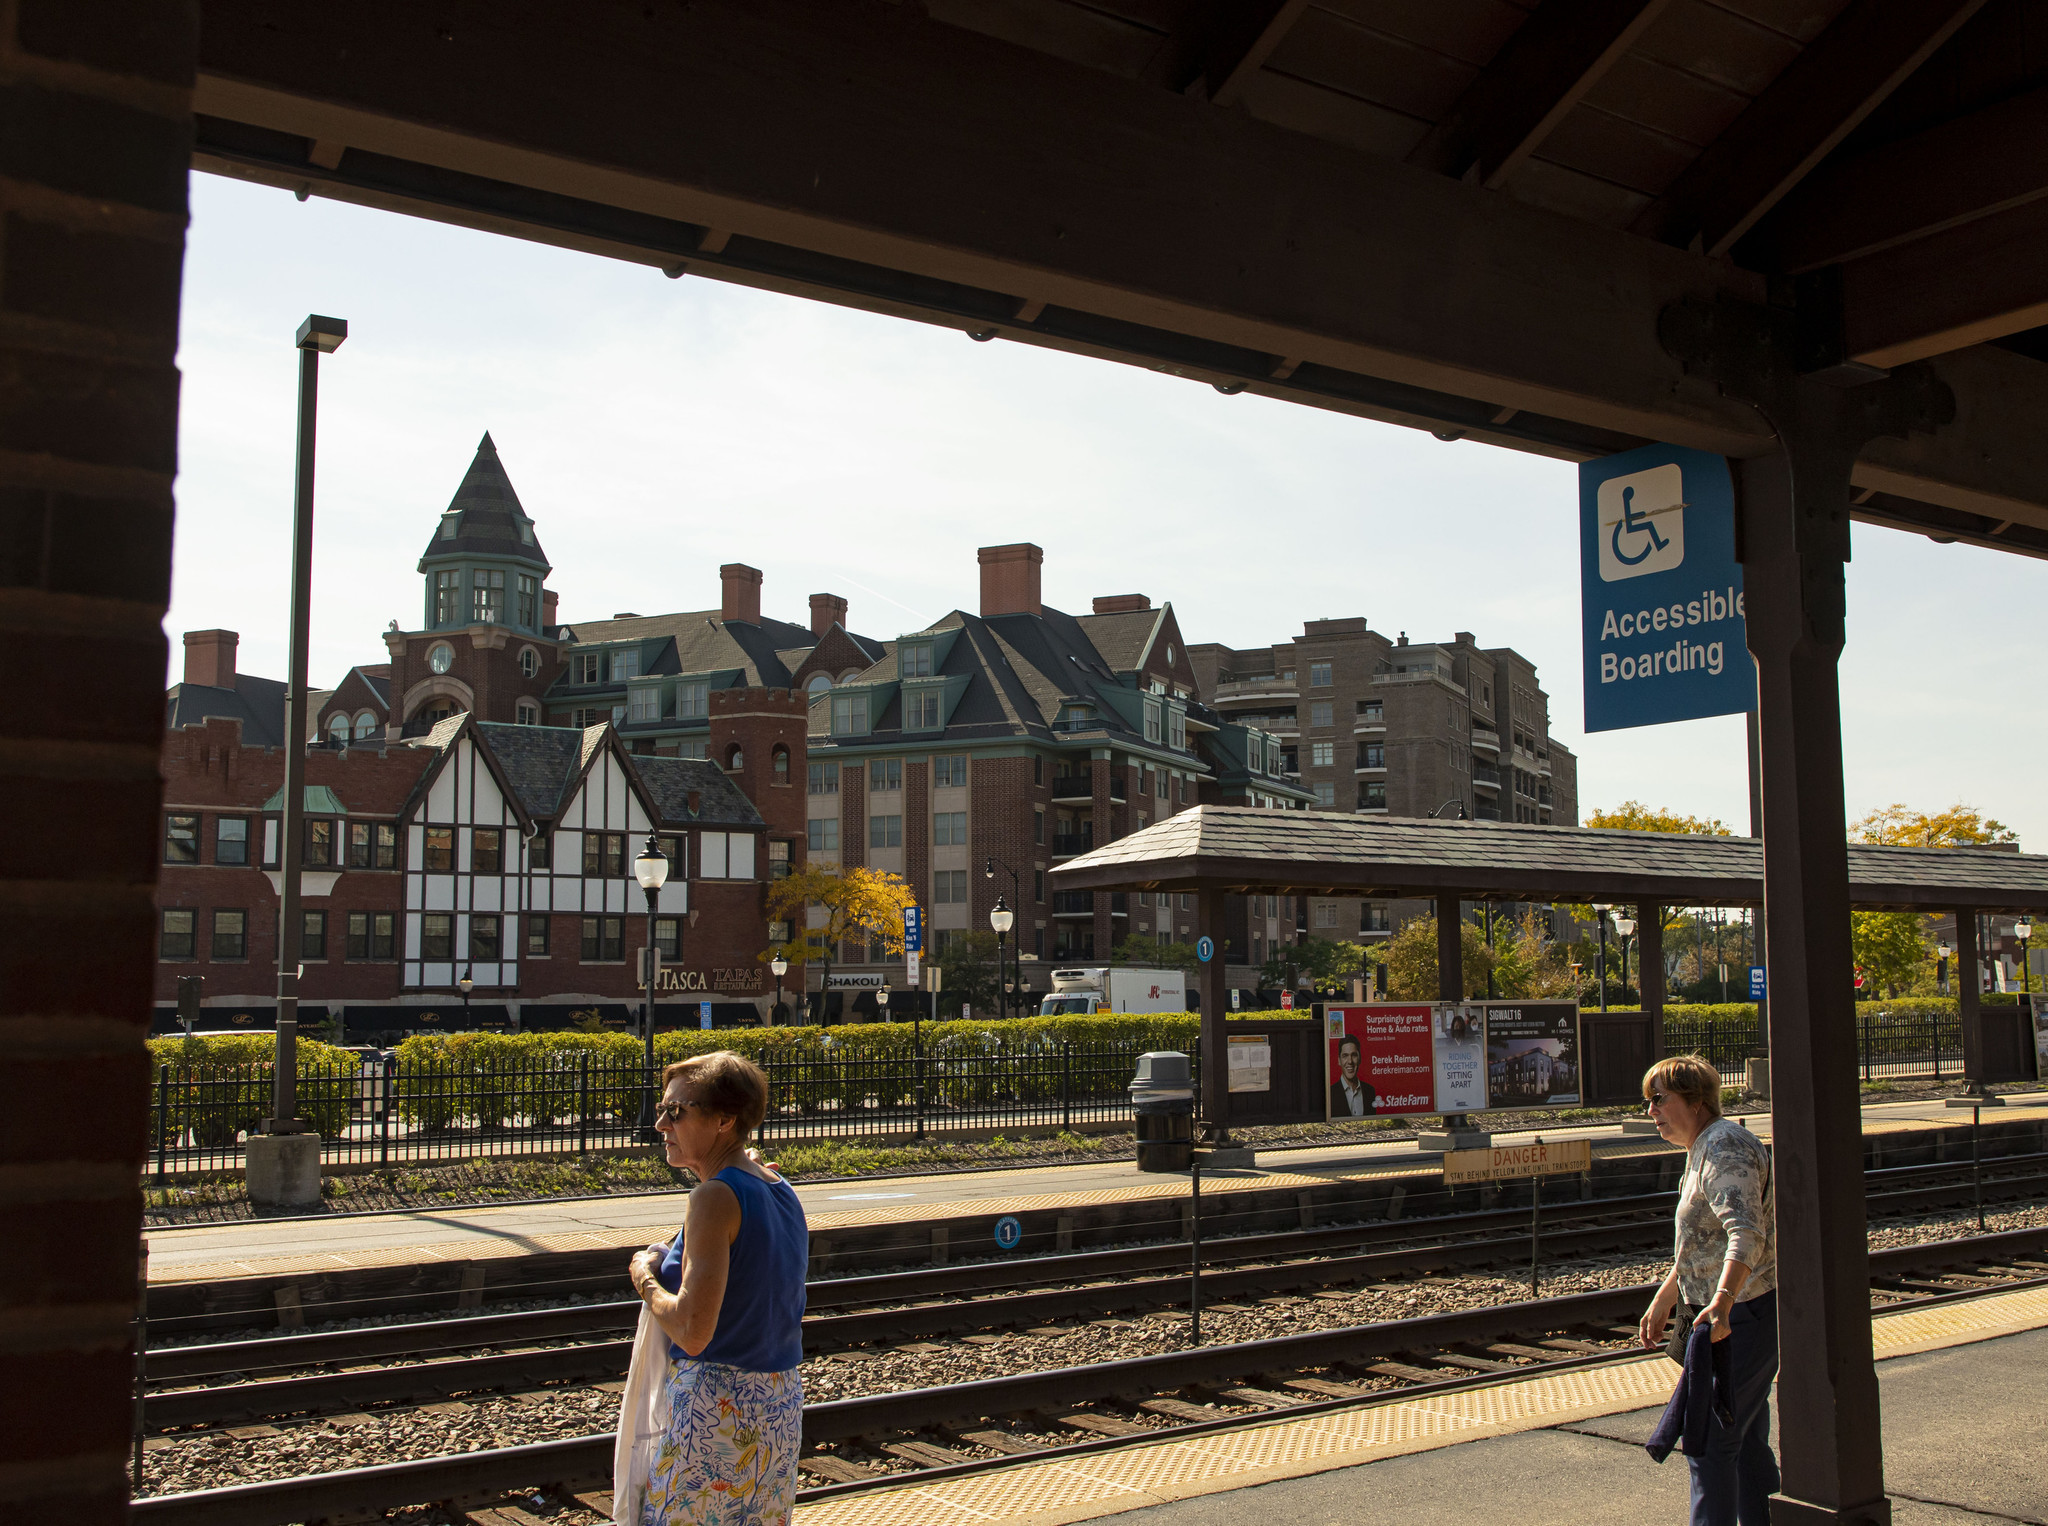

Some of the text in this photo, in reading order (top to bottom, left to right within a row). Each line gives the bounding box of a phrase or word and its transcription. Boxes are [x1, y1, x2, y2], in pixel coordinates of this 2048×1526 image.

[1601, 640, 1723, 684] Boarding
[1202, 942, 1207, 955] 1
[661, 968, 708, 990] TASCA
[713, 968, 763, 981] TAPAS
[826, 977, 880, 987] SHAKOU
[714, 982, 762, 990] RESTAURANT
[1148, 985, 1160, 999] JFC
[1366, 1014, 1423, 1025] Surprisingly great
[1366, 1024, 1429, 1034] Home & Auto rates
[1371, 1054, 1420, 1065] Derek Reiman
[1448, 1052, 1472, 1060] RIDING
[1371, 1065, 1430, 1075] derekreiman.com
[1443, 1062, 1478, 1070] TOGETHER
[1446, 1071, 1473, 1080] SITTING
[1450, 1080, 1472, 1089] APART
[1493, 1146, 1547, 1167] DANGER
[1450, 1160, 1587, 1181] STAY BEHIND YELLOW LINE UNTIL TRAIN STOPS
[1004, 1224, 1011, 1240] 1
